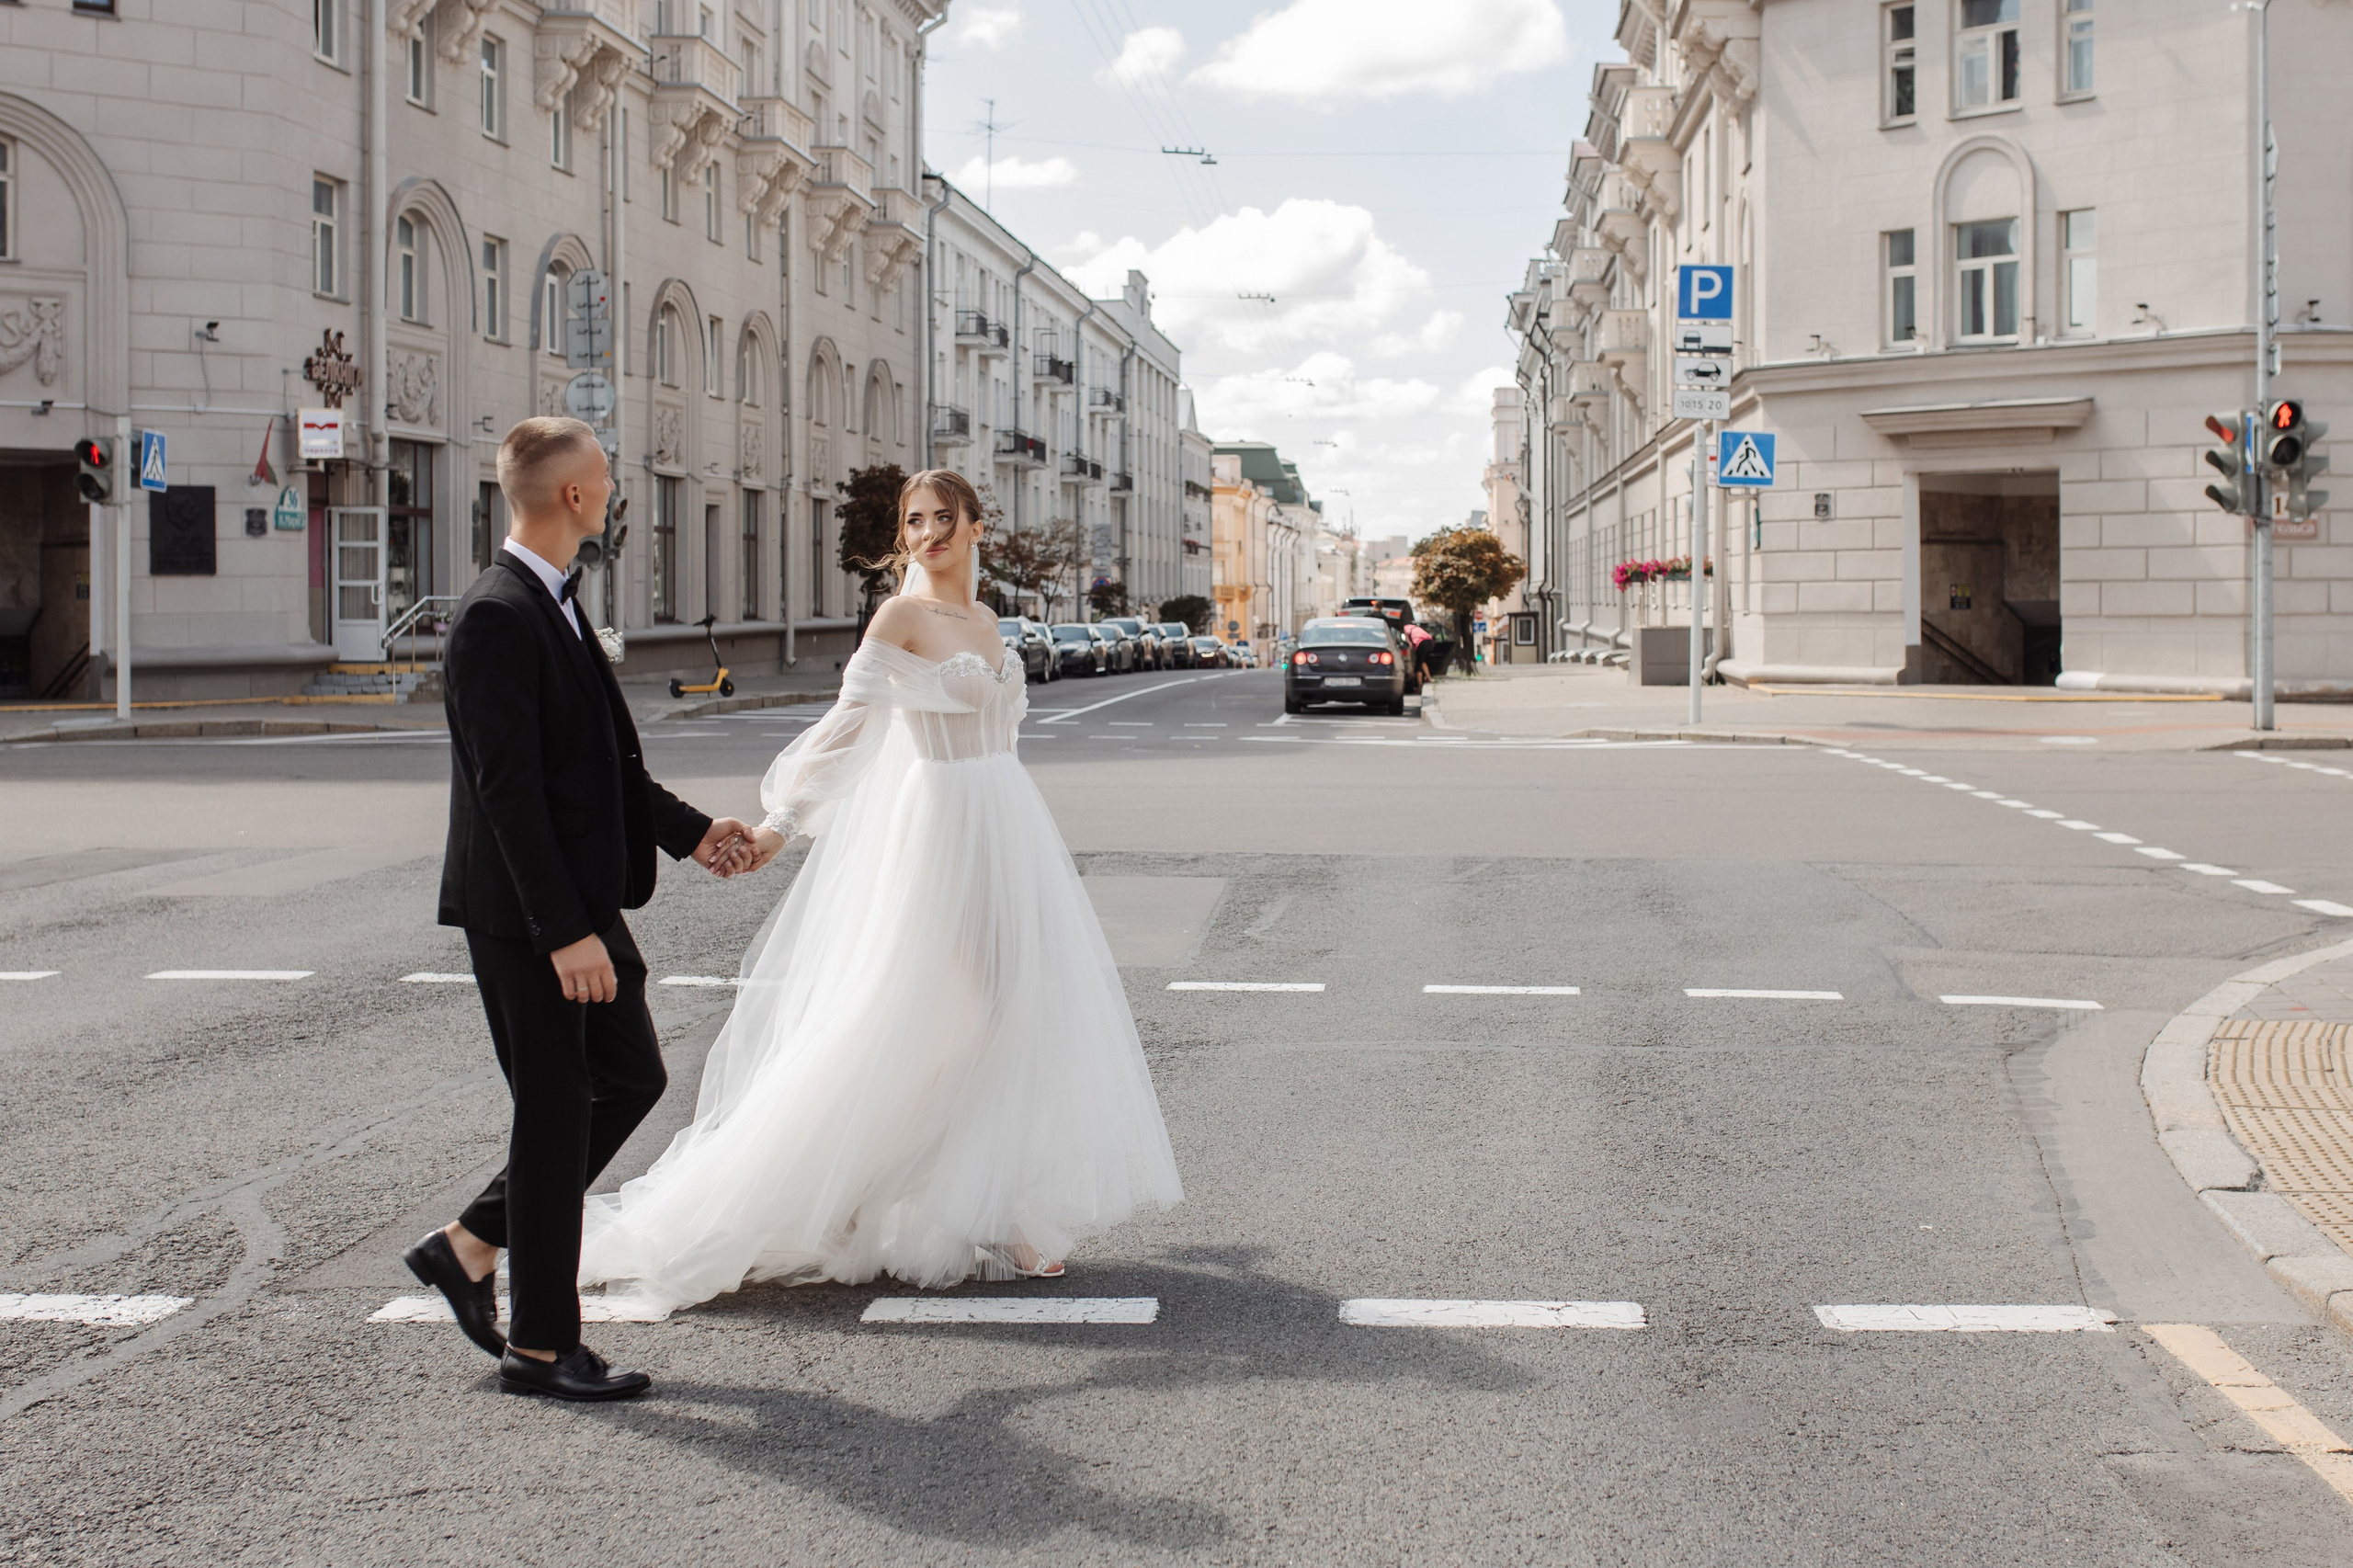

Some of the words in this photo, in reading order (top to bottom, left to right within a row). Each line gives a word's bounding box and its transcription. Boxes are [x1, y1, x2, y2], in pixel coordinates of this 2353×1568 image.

[1690, 270, 1722, 314] P
[1681, 400, 1691, 408] 10
[1693, 400, 1703, 409] 15
[1709, 400, 1722, 410] 20
[287, 489, 298, 508] 36
